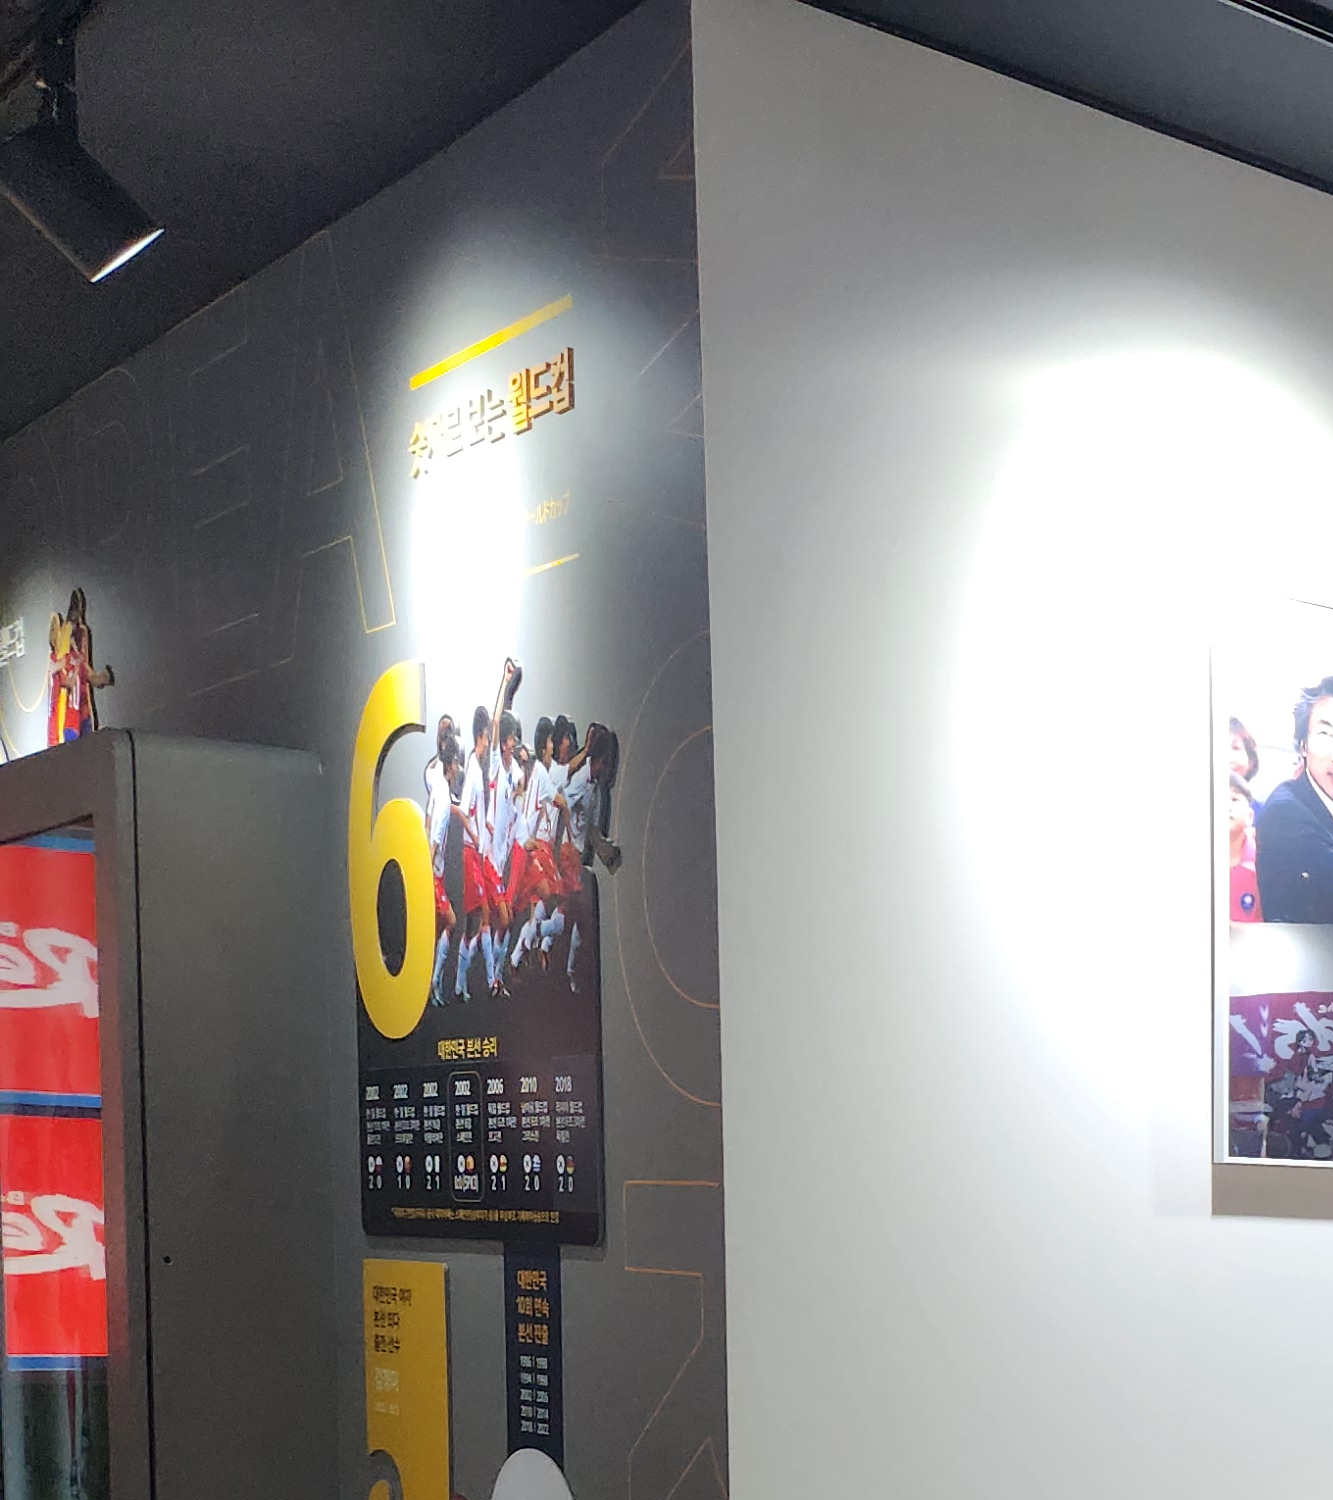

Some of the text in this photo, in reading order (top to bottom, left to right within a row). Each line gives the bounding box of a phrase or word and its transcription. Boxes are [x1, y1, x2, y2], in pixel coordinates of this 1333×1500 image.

[509, 346, 575, 435] 월드컵
[348, 660, 436, 1040] 6
[482, 1036, 497, 1057] 승리
[455, 1080, 471, 1096] 2002
[487, 1078, 504, 1095] 2006
[520, 1076, 537, 1093] 2010
